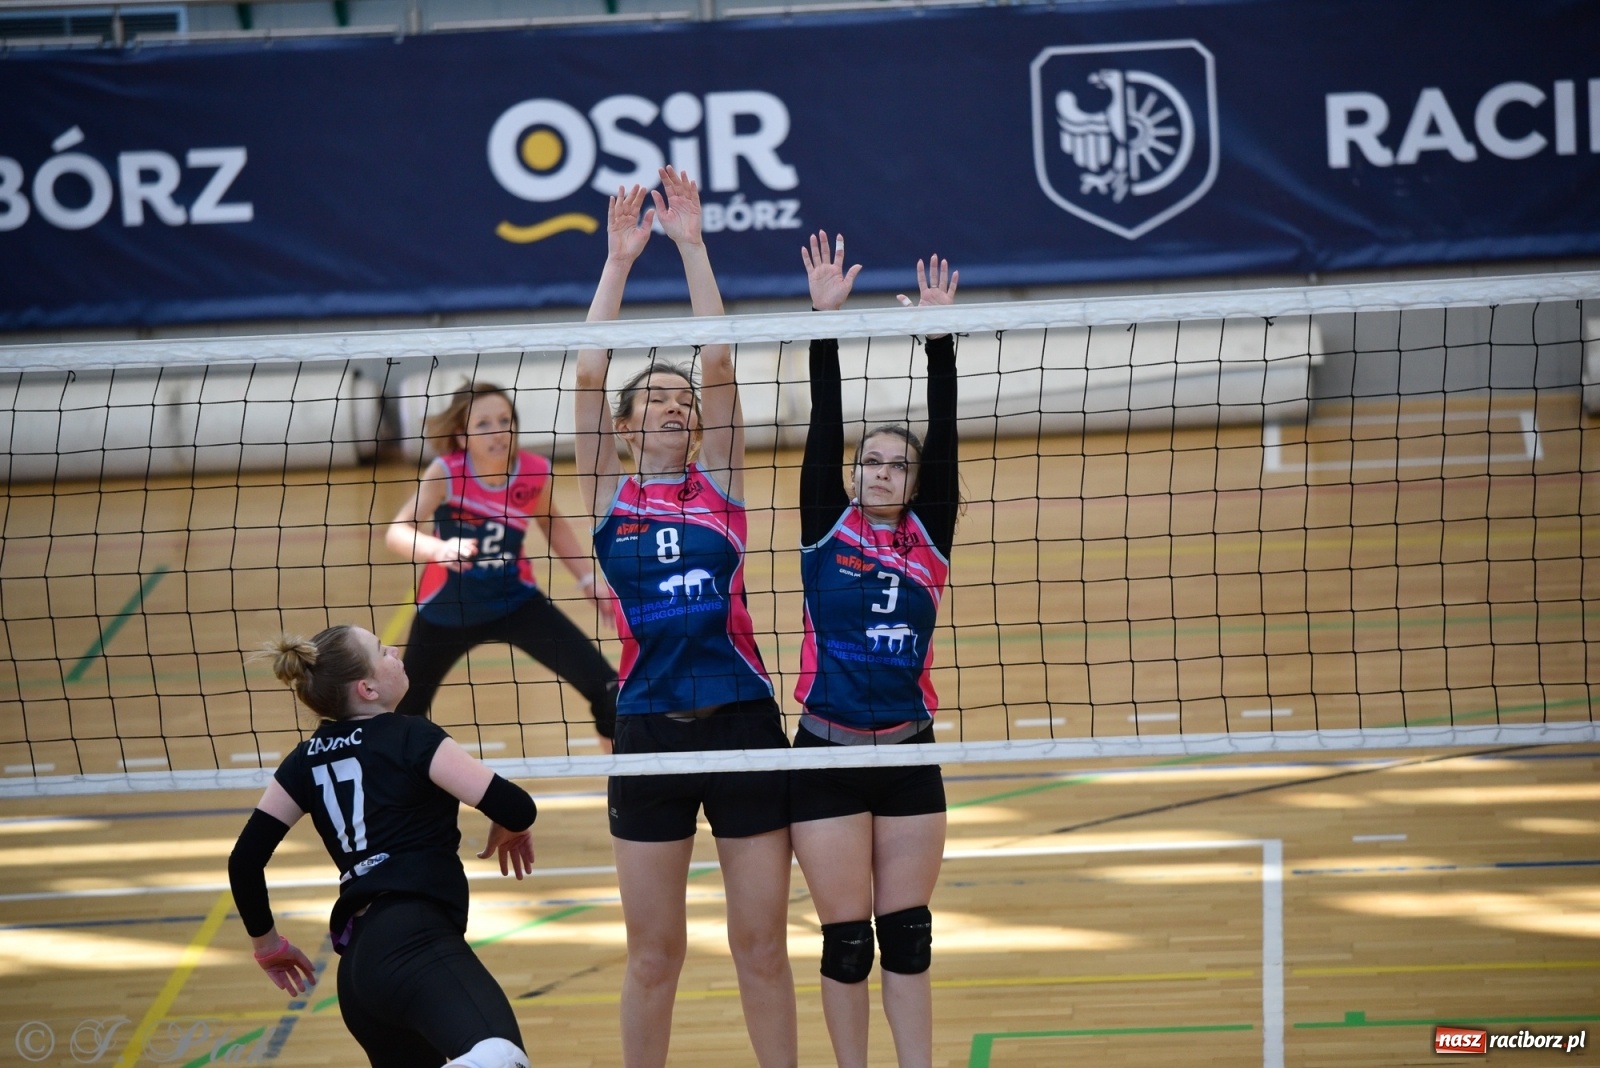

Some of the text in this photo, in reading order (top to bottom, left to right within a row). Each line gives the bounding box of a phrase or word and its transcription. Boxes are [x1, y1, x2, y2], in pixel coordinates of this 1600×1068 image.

[1325, 78, 1600, 169] RACI
[481, 521, 505, 555] 2
[656, 527, 680, 564] 8
[871, 571, 900, 614] 3
[630, 601, 723, 626] ENERGOSERWIS
[311, 756, 368, 854] 17
